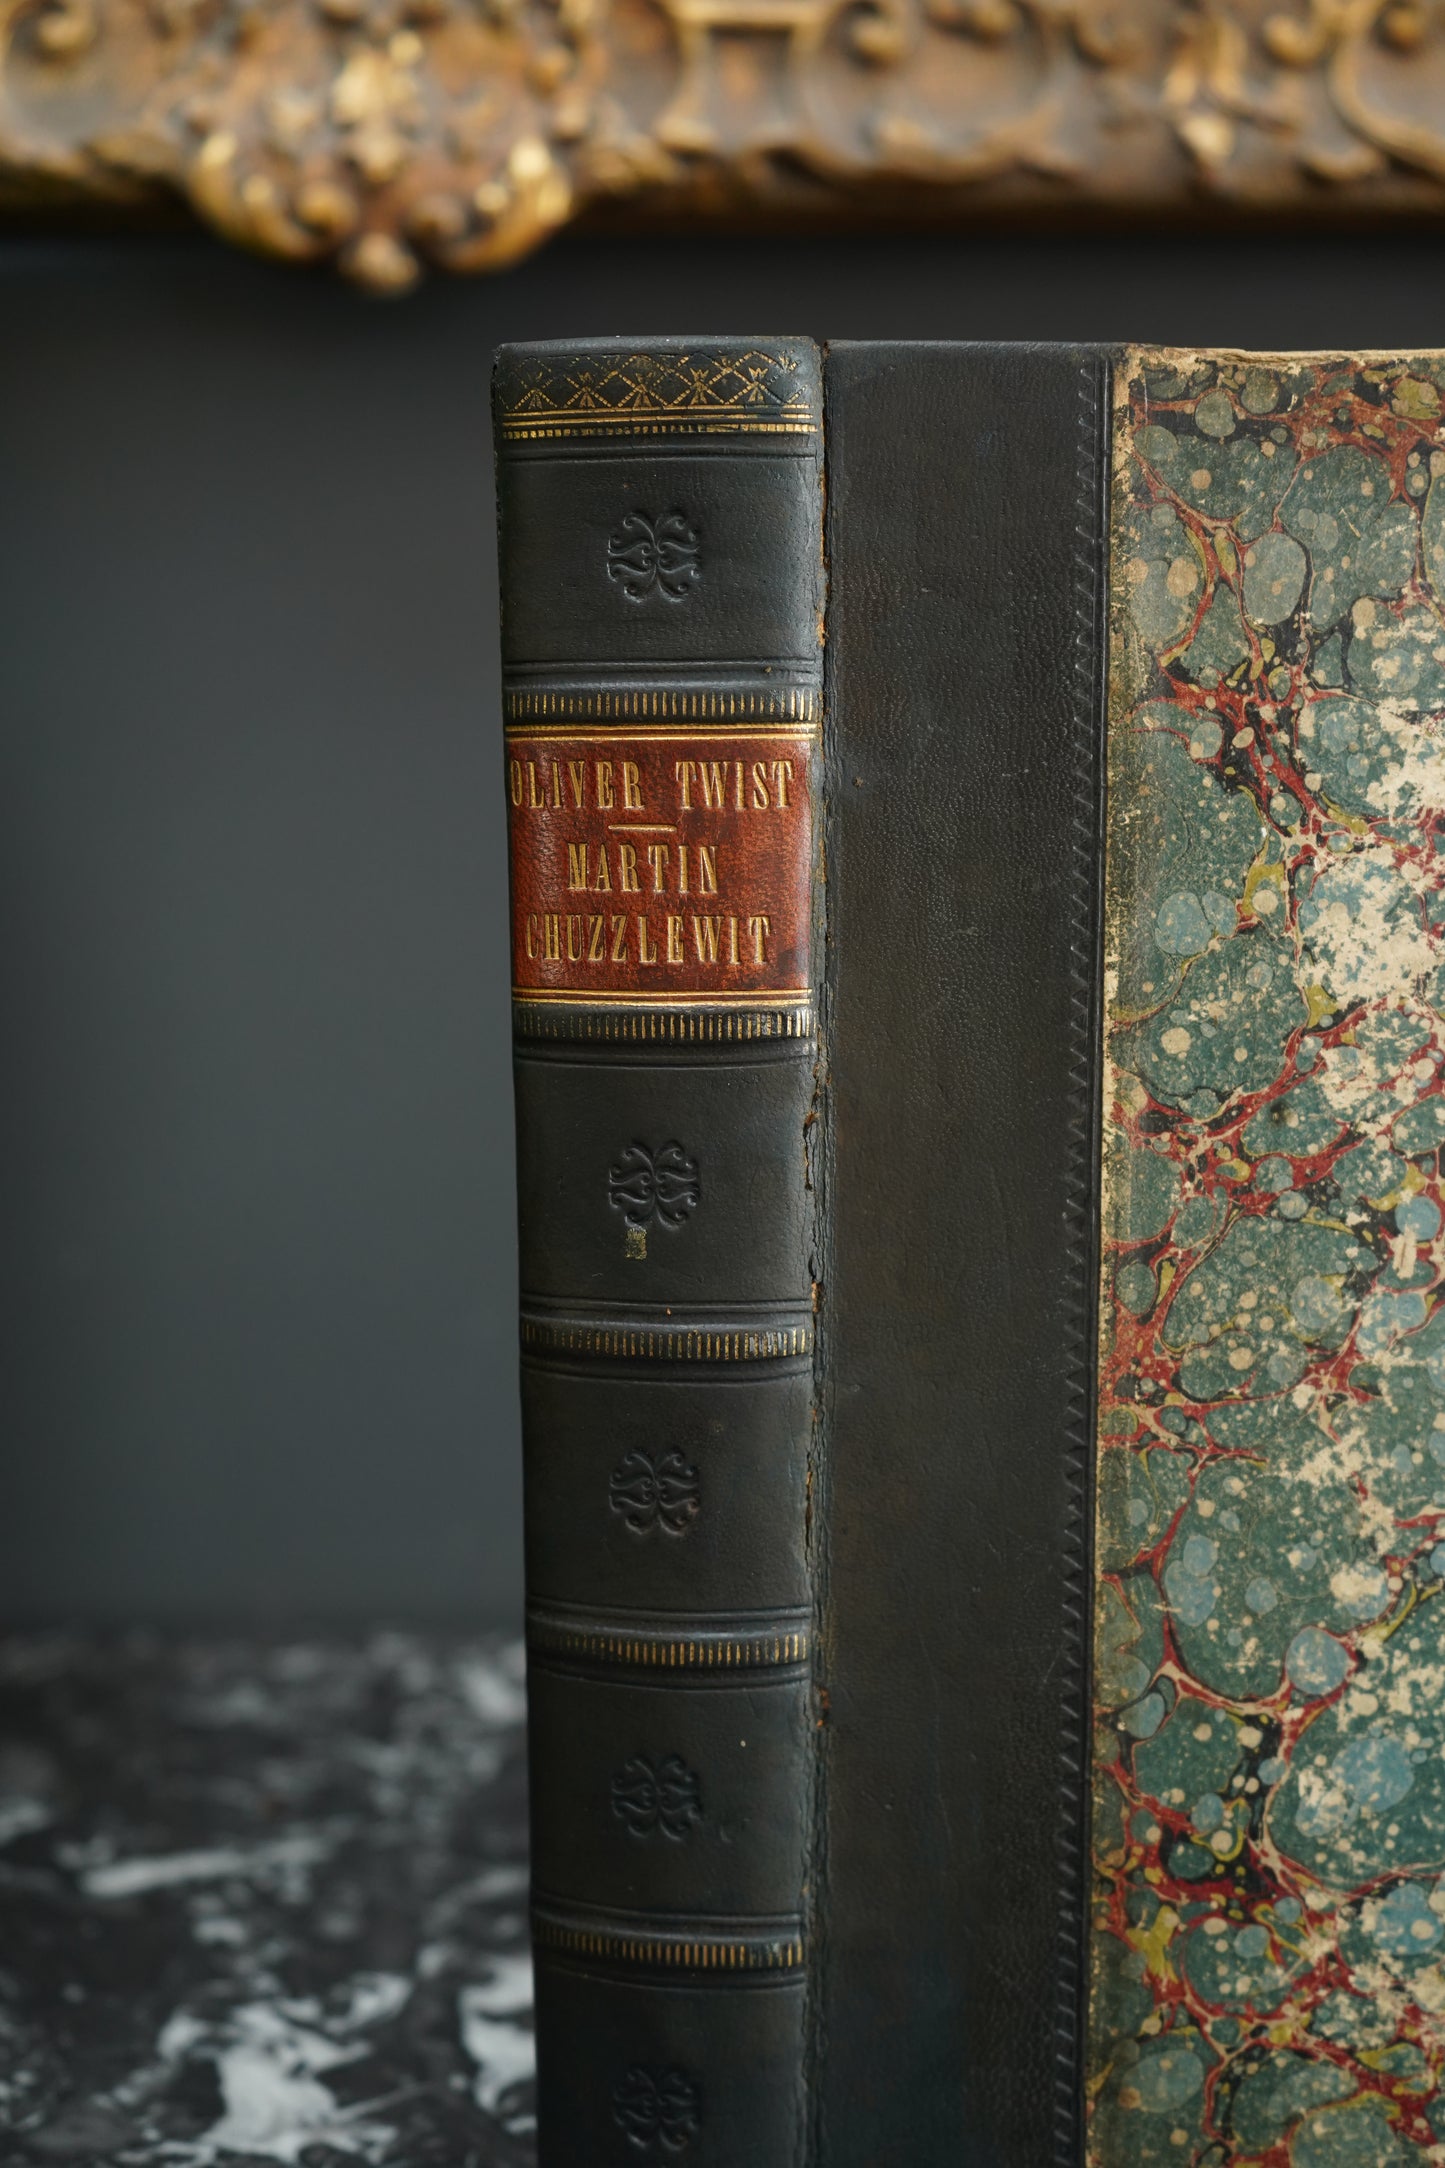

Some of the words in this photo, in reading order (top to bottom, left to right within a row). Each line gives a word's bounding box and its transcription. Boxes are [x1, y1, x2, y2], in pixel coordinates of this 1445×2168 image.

[510, 758, 645, 811] OLIVER
[675, 760, 794, 811] TWIST
[567, 843, 718, 894] MARTIN
[526, 912, 771, 965] CHUZZLEWIT
